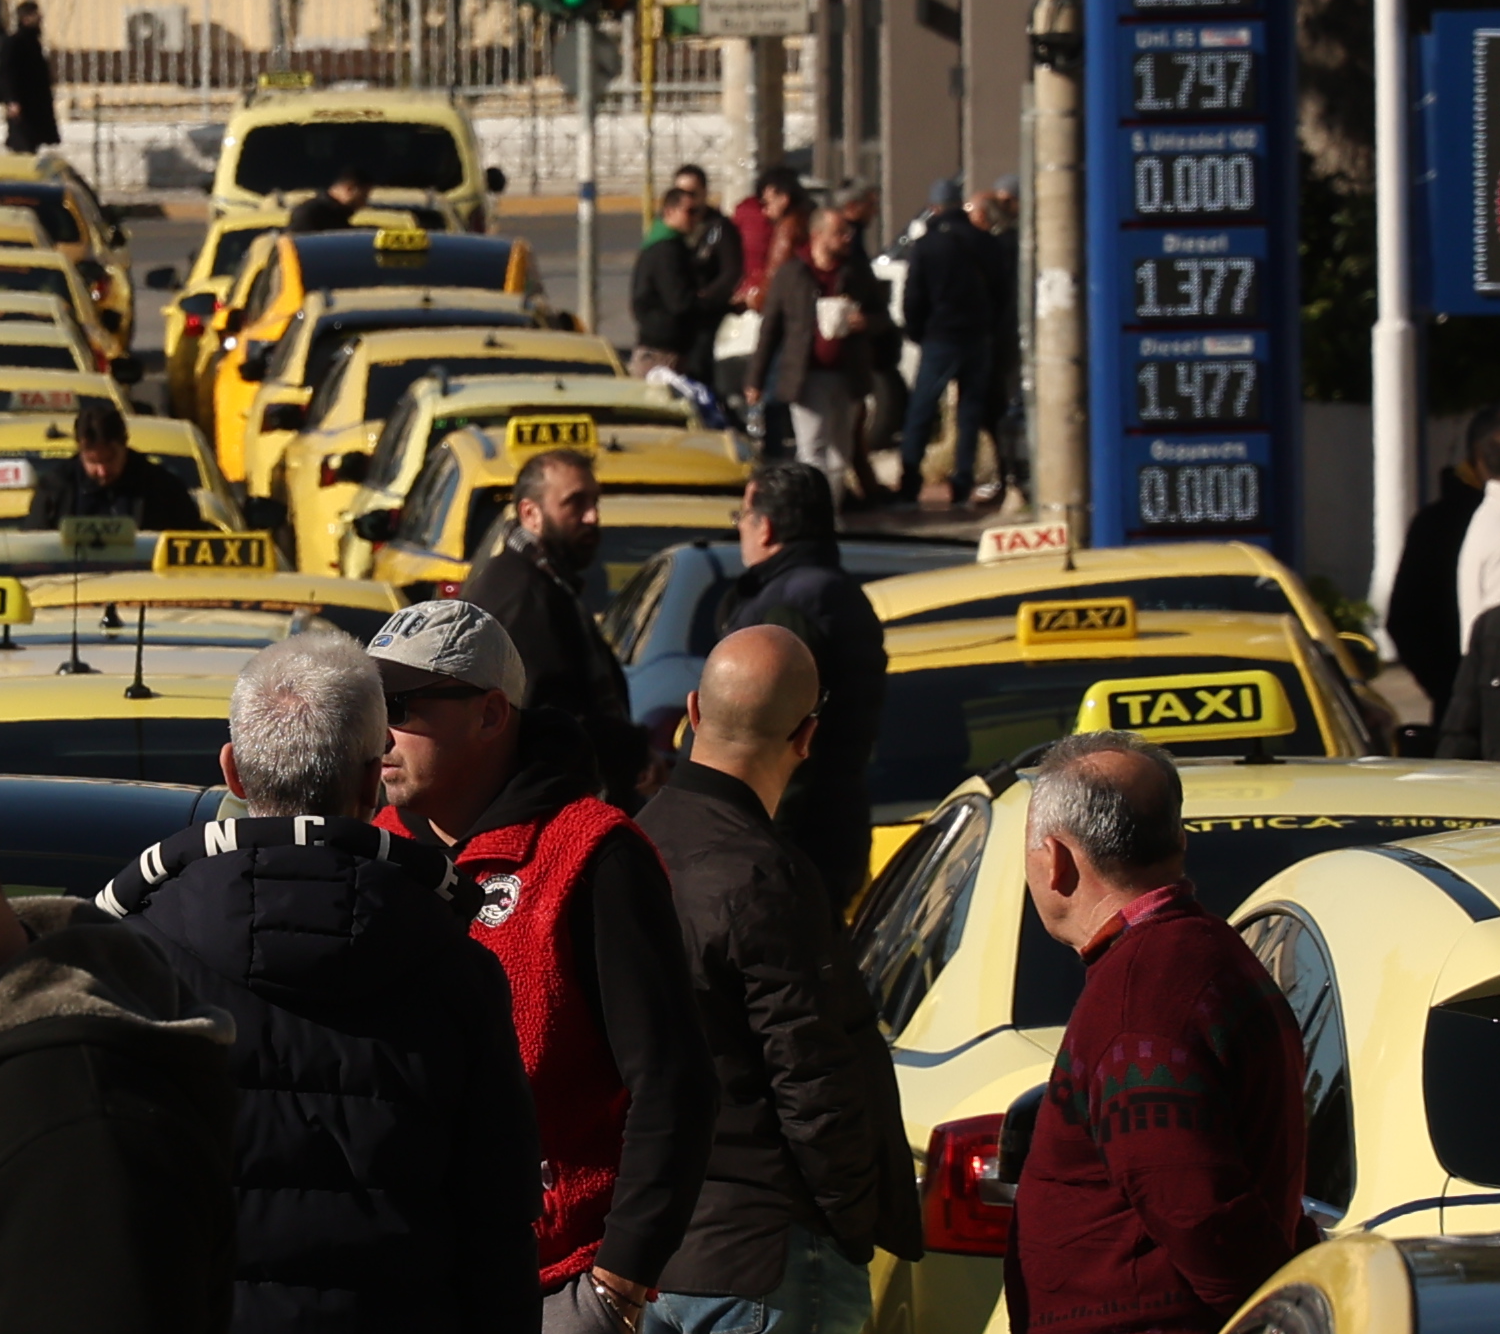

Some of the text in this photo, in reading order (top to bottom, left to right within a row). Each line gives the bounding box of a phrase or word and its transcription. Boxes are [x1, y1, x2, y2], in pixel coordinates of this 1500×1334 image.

[1134, 51, 1252, 110] 1.797
[1135, 153, 1254, 213] 0.000
[1162, 233, 1229, 254] Diesel
[1135, 257, 1255, 316] 1.377
[1138, 361, 1256, 419] 1.477
[1139, 466, 1259, 523] 0.000
[172, 539, 262, 565] TAXI
[989, 526, 1067, 554] TAXI
[1037, 605, 1123, 630] TAXI
[1116, 686, 1255, 725] TAXI
